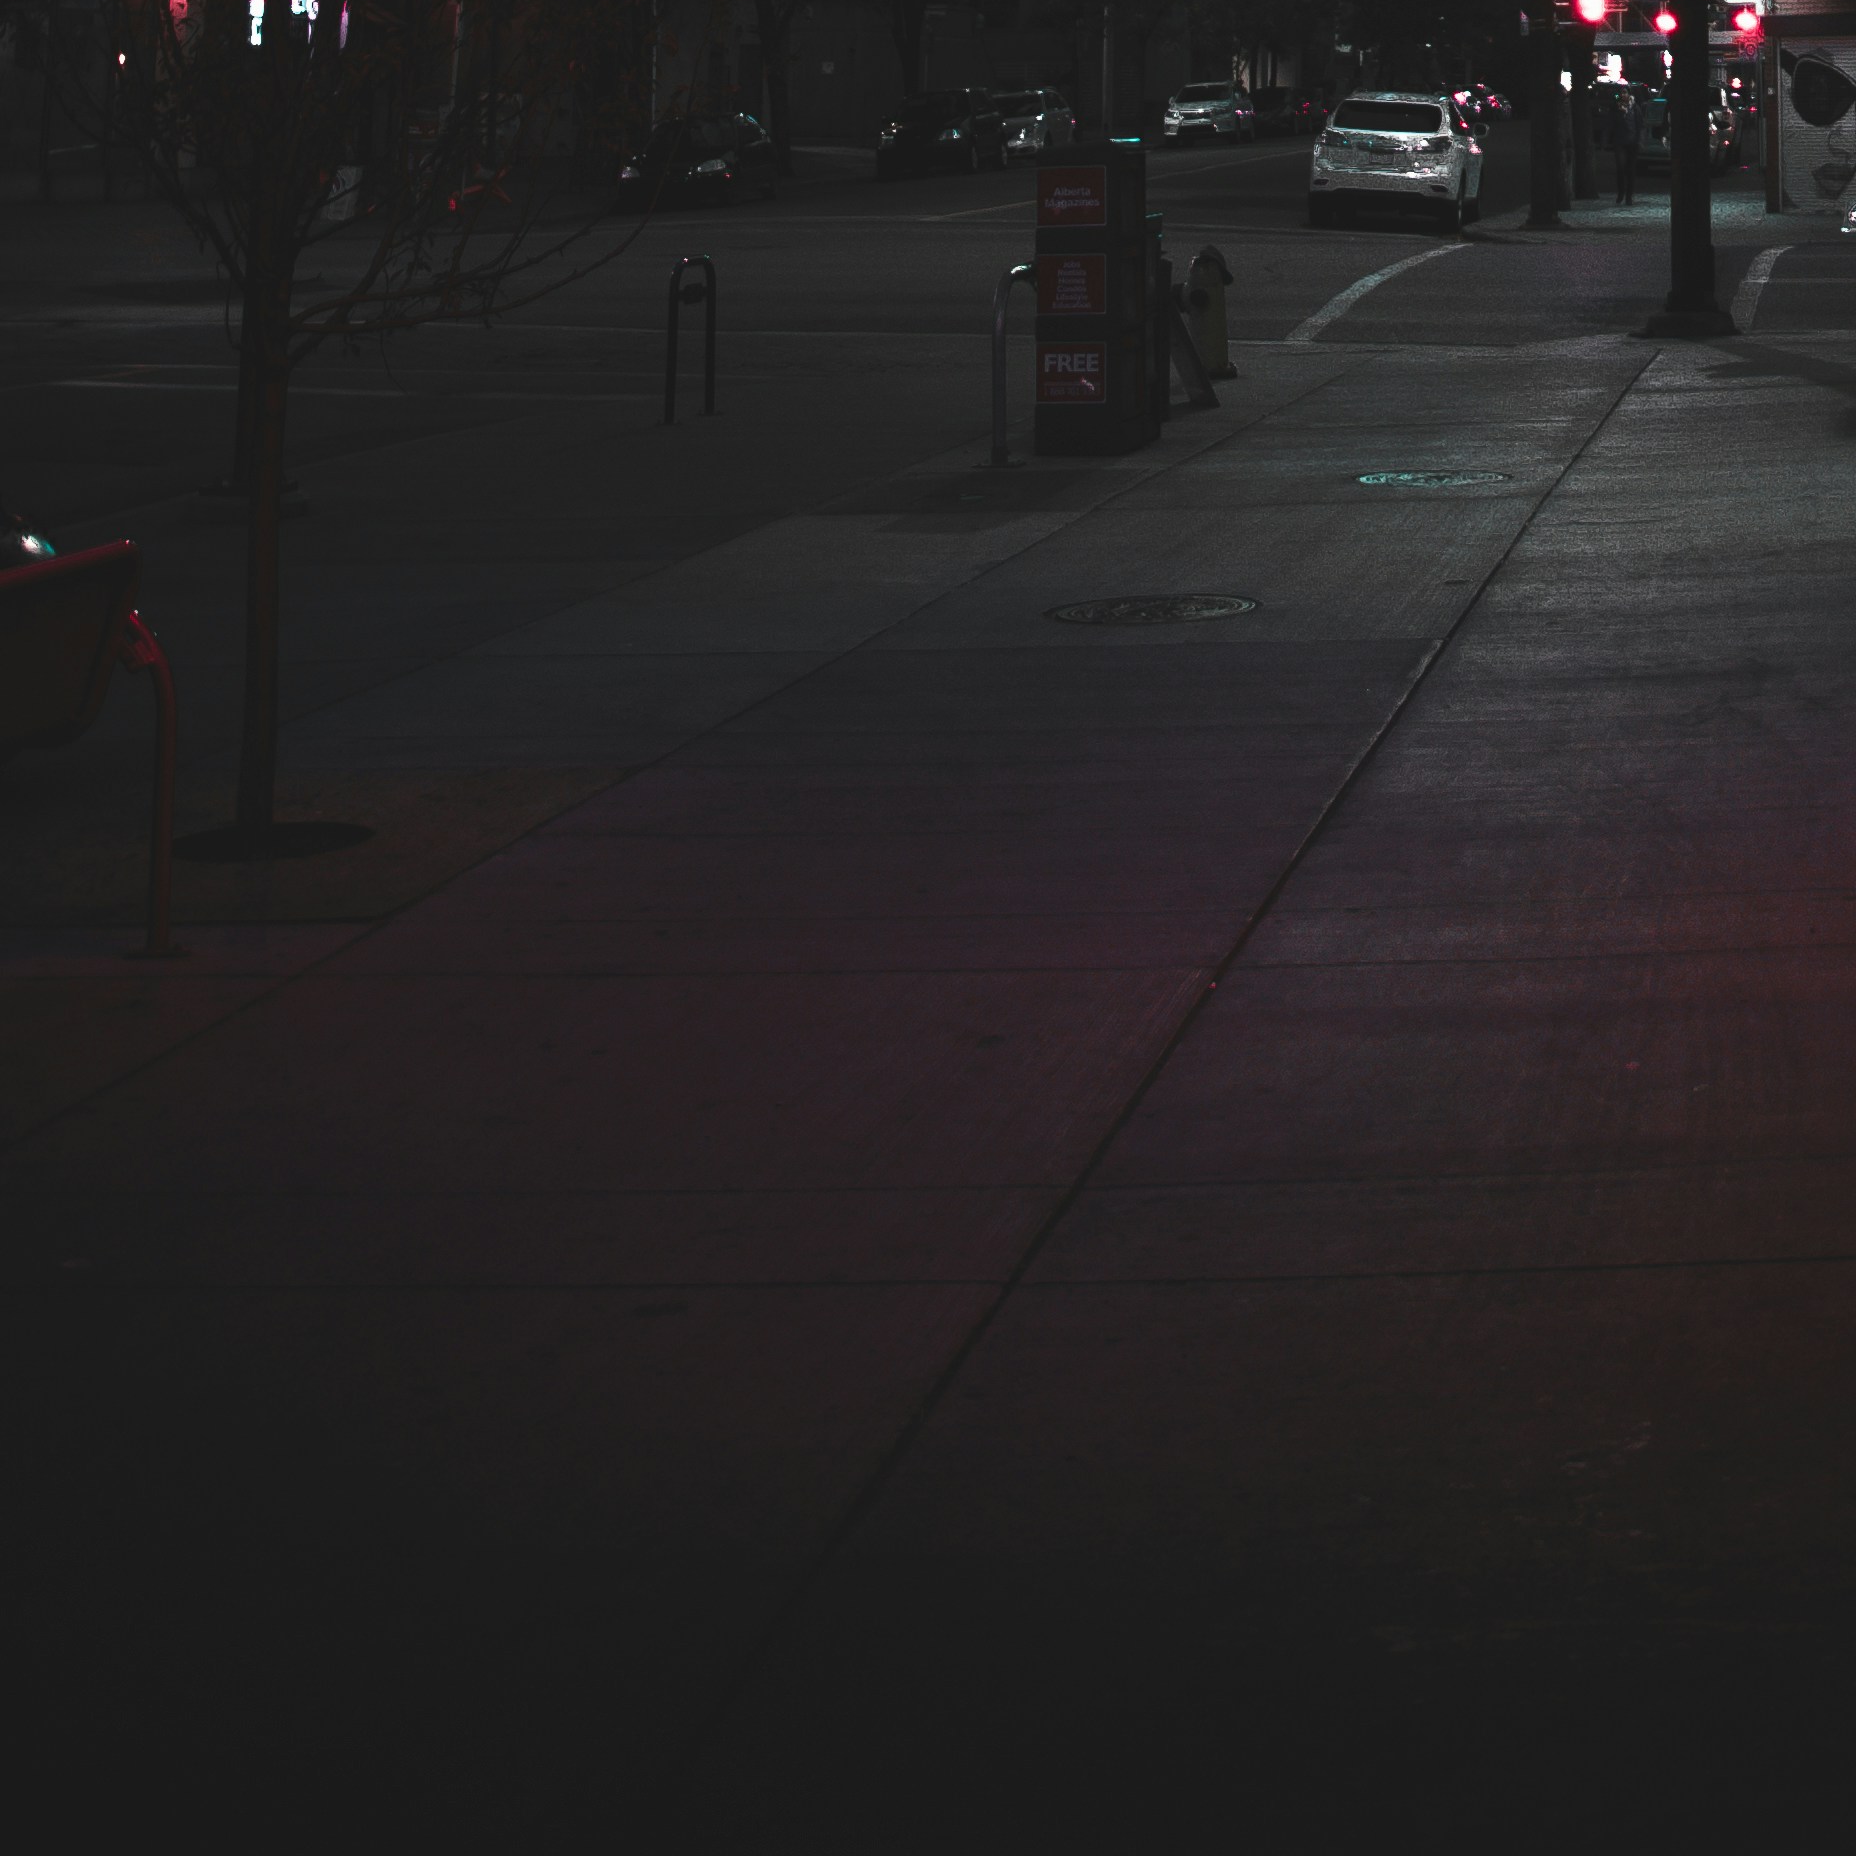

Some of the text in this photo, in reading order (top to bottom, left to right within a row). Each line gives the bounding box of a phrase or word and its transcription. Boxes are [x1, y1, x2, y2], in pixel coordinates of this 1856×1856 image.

[1053, 186, 1091, 197] Alberta
[1044, 197, 1100, 210] Magazines
[1043, 353, 1100, 373] FREE
